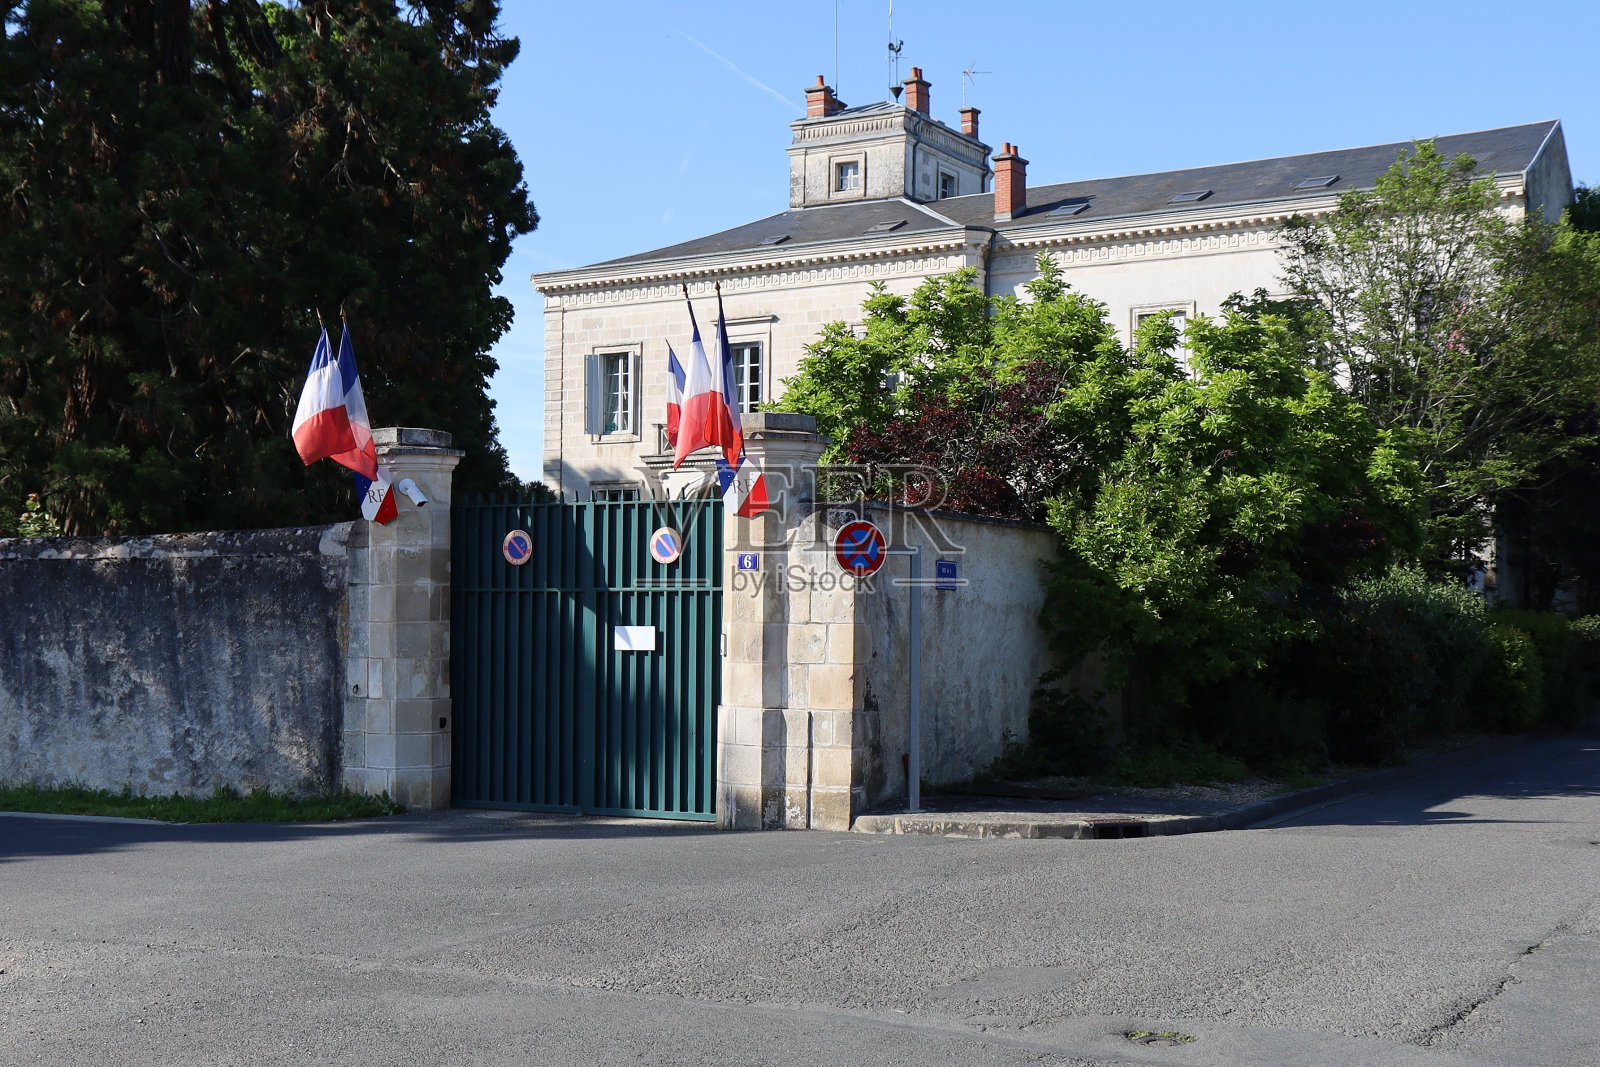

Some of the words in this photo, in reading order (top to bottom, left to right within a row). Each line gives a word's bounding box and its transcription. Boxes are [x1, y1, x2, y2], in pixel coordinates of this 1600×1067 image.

[732, 479, 753, 494] RF
[367, 488, 385, 503] RF
[743, 554, 752, 569] 6
